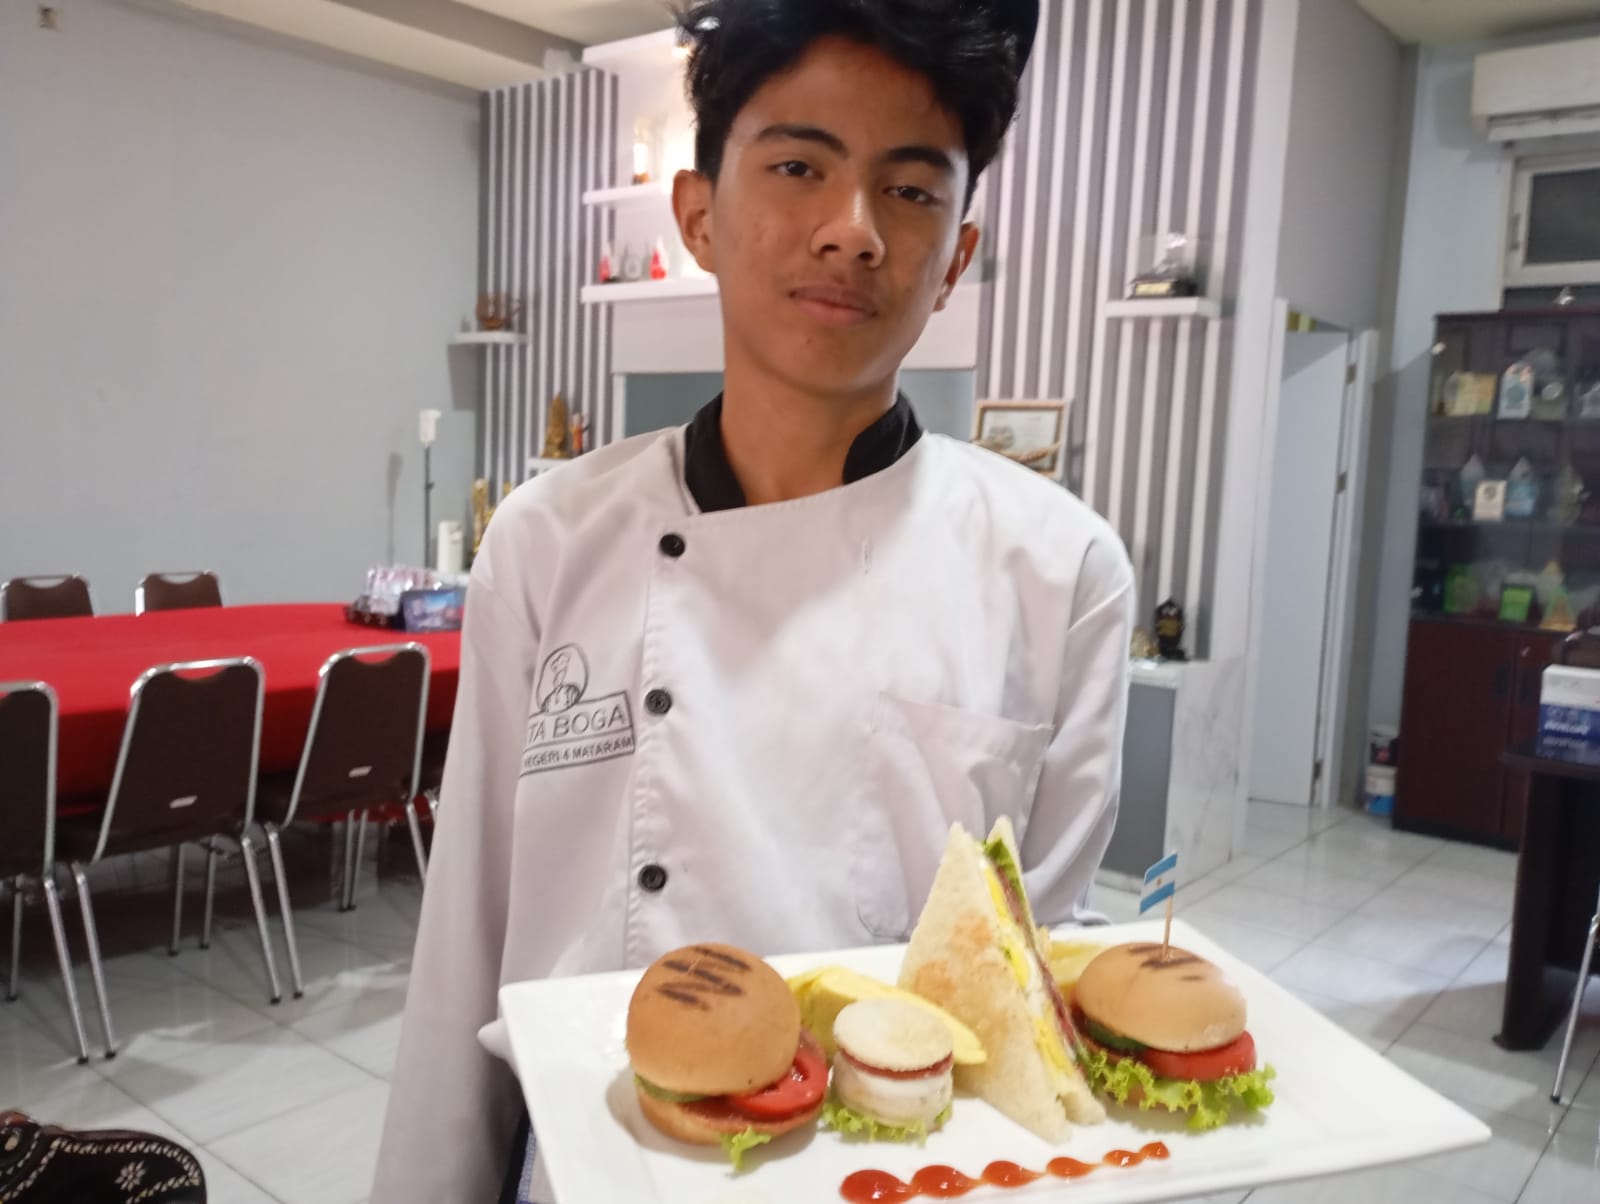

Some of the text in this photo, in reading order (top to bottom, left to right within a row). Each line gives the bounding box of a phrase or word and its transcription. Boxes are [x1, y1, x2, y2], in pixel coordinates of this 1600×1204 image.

[553, 704, 625, 738] BOGA
[524, 737, 632, 768] EGERI 4 MATARAM
